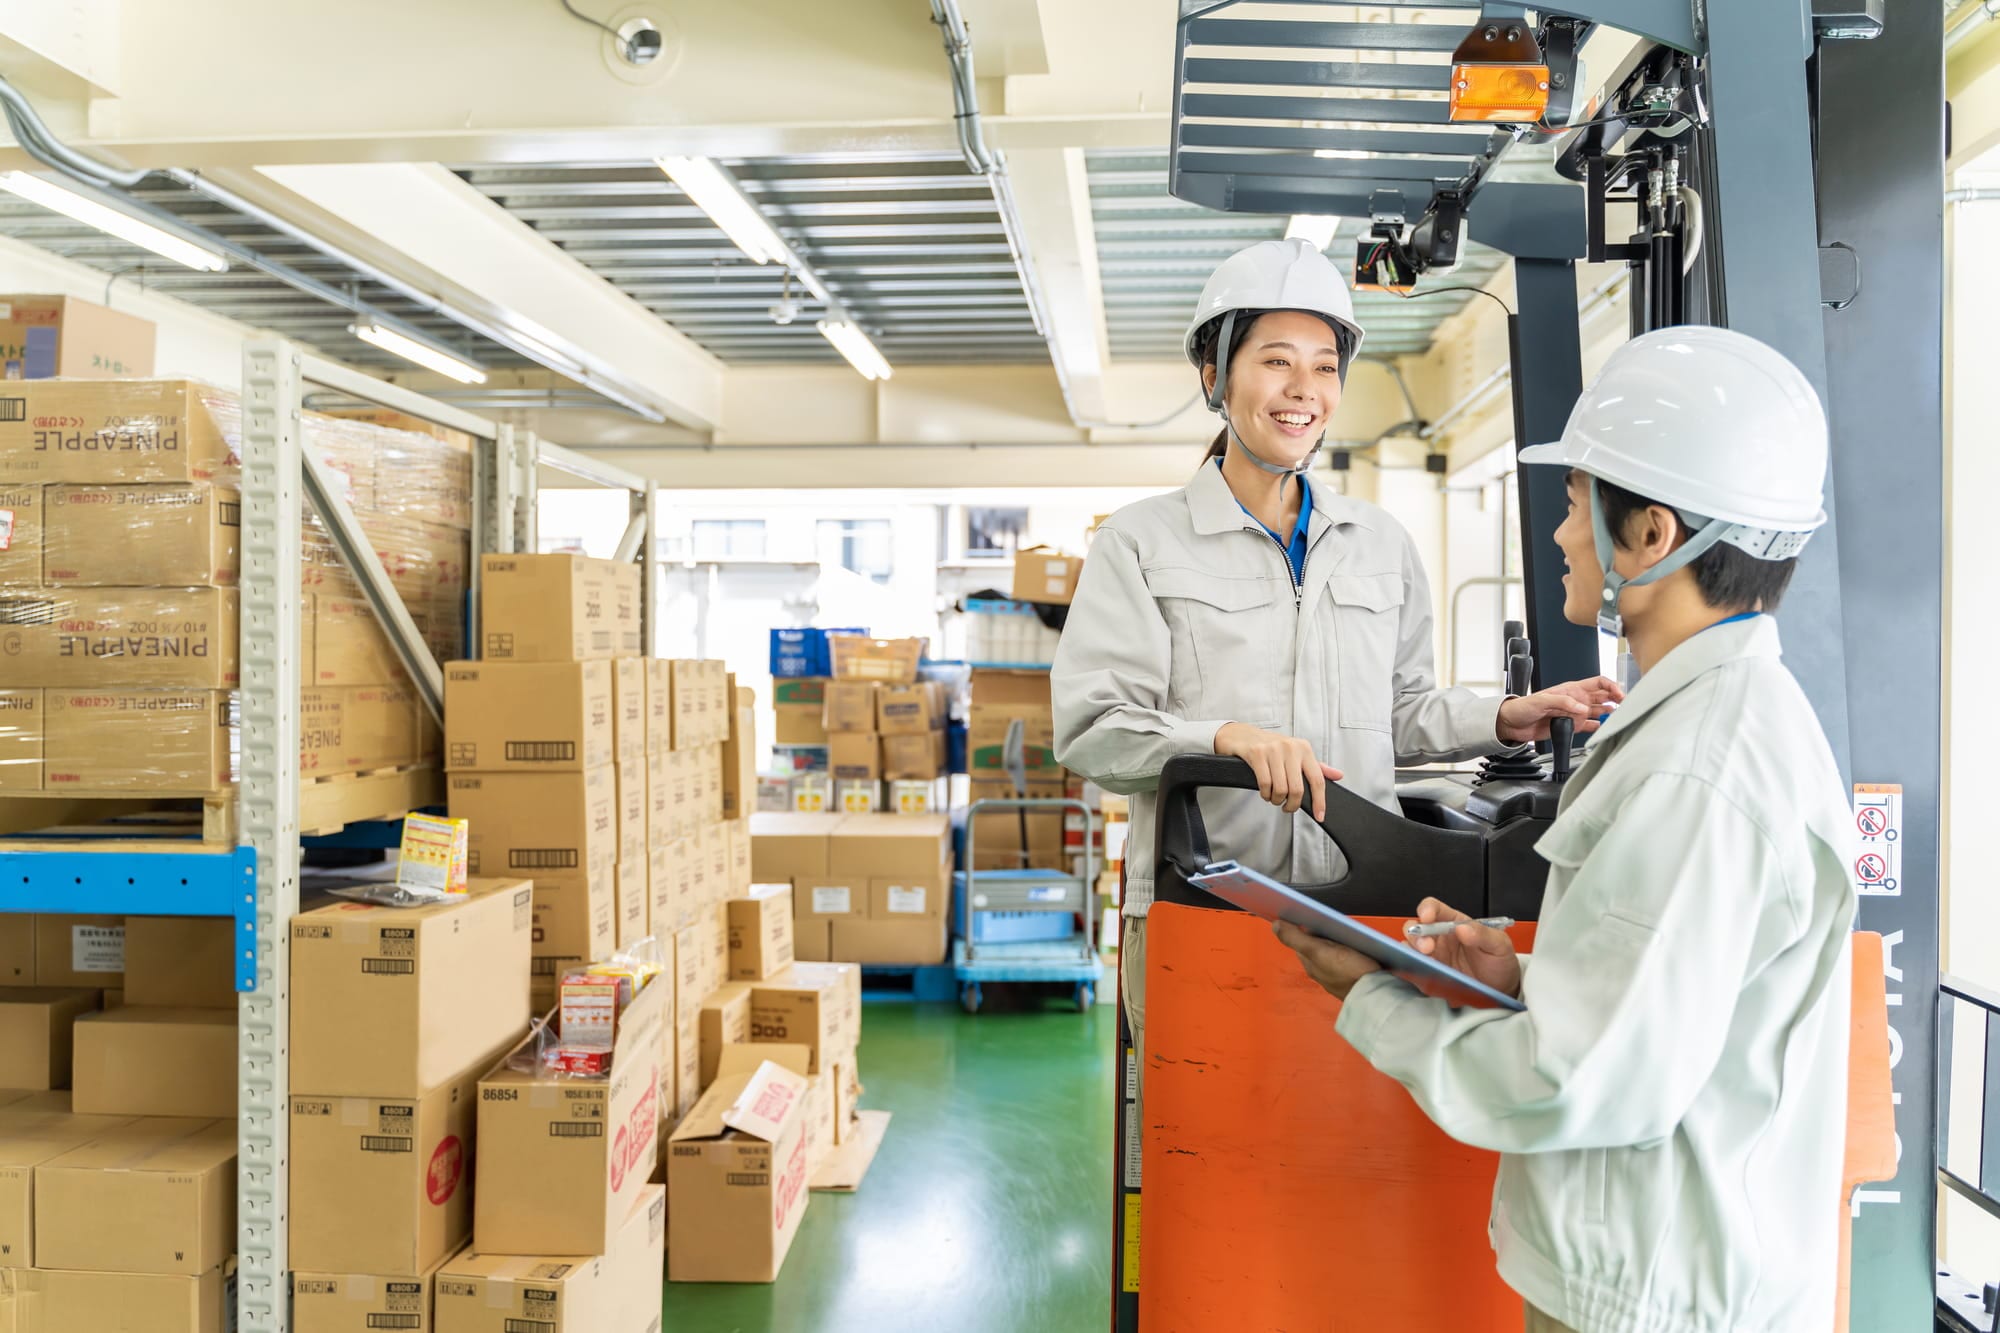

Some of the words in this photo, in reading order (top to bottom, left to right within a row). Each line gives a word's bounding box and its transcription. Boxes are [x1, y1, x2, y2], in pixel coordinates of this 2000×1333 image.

[33, 430, 178, 451] PINEAPPLE
[58, 636, 208, 657] PINEAPPLE
[118, 696, 205, 710] PINEAPPLE
[482, 1088, 519, 1101] 86854
[1, 1244, 11, 1255] W
[174, 1251, 184, 1261] W
